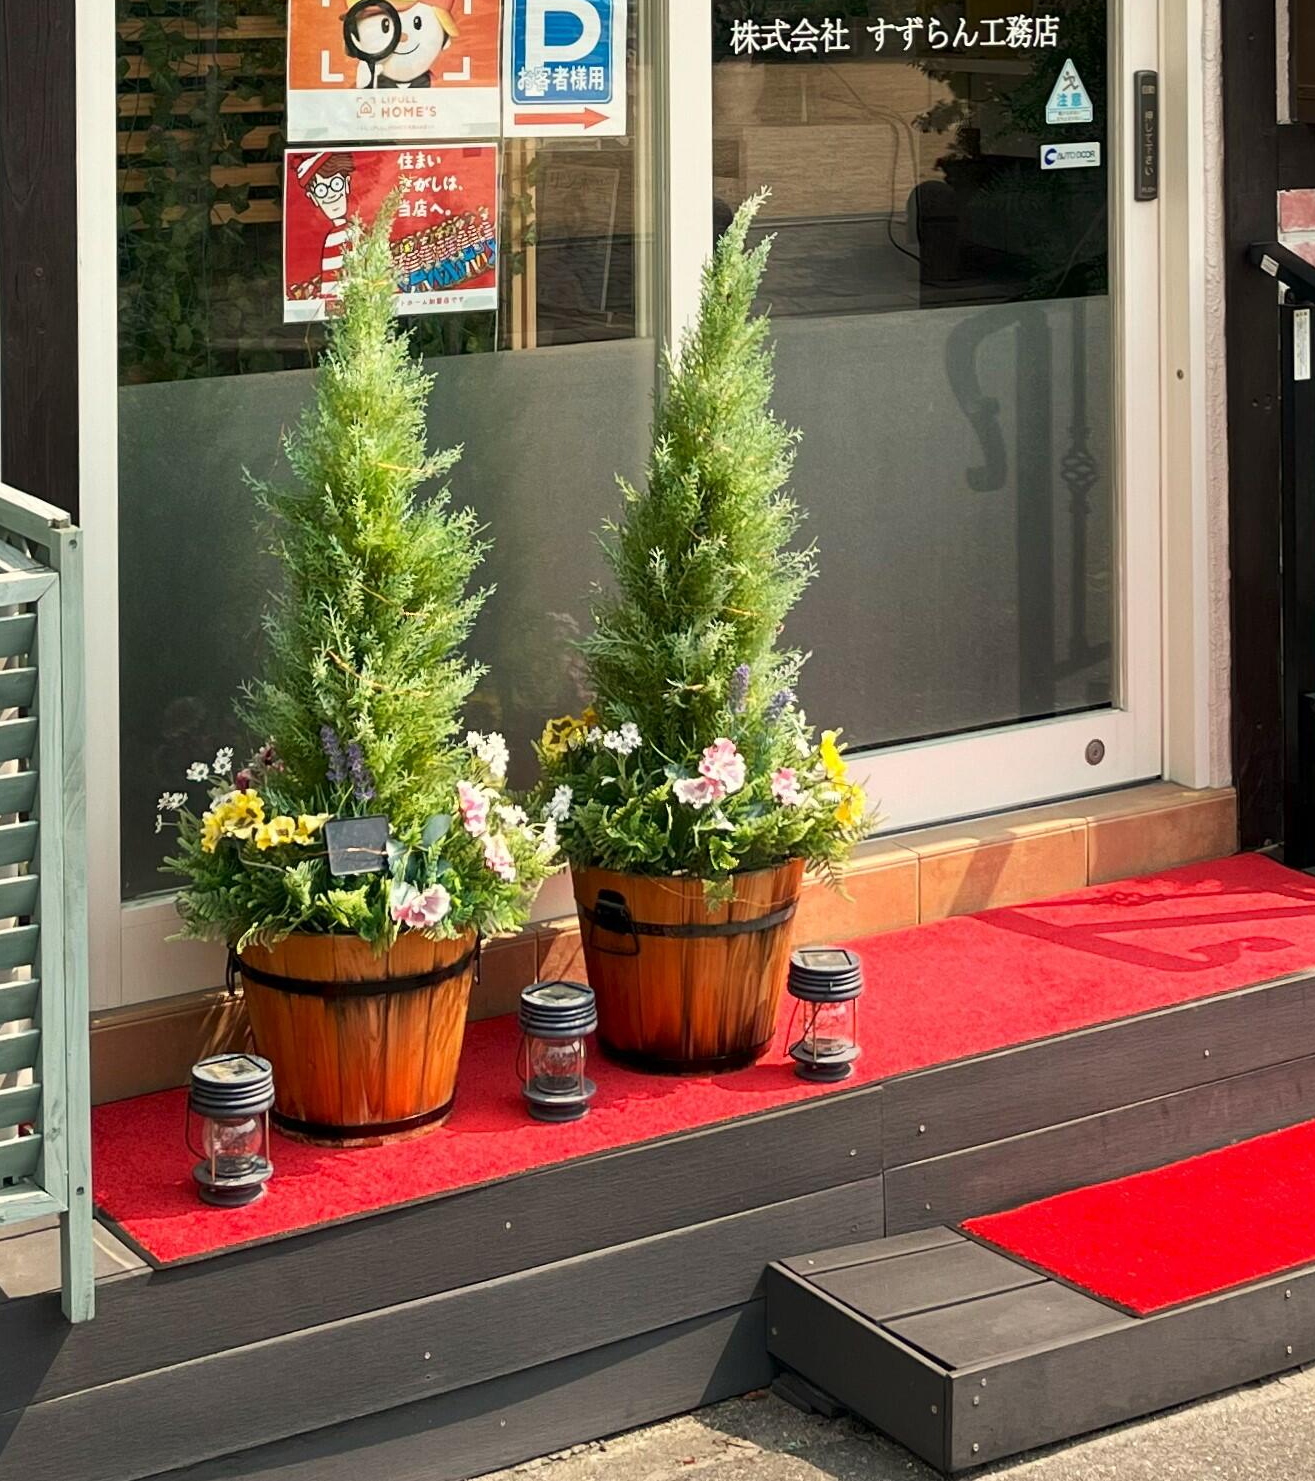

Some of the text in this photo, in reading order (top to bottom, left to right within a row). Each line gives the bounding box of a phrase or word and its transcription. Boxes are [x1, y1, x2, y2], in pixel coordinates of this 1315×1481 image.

[730, 14, 1060, 55] 株式会社 すずらん工務店
[381, 106, 437, 118] HOME'S
[397, 152, 442, 170] 住まい
